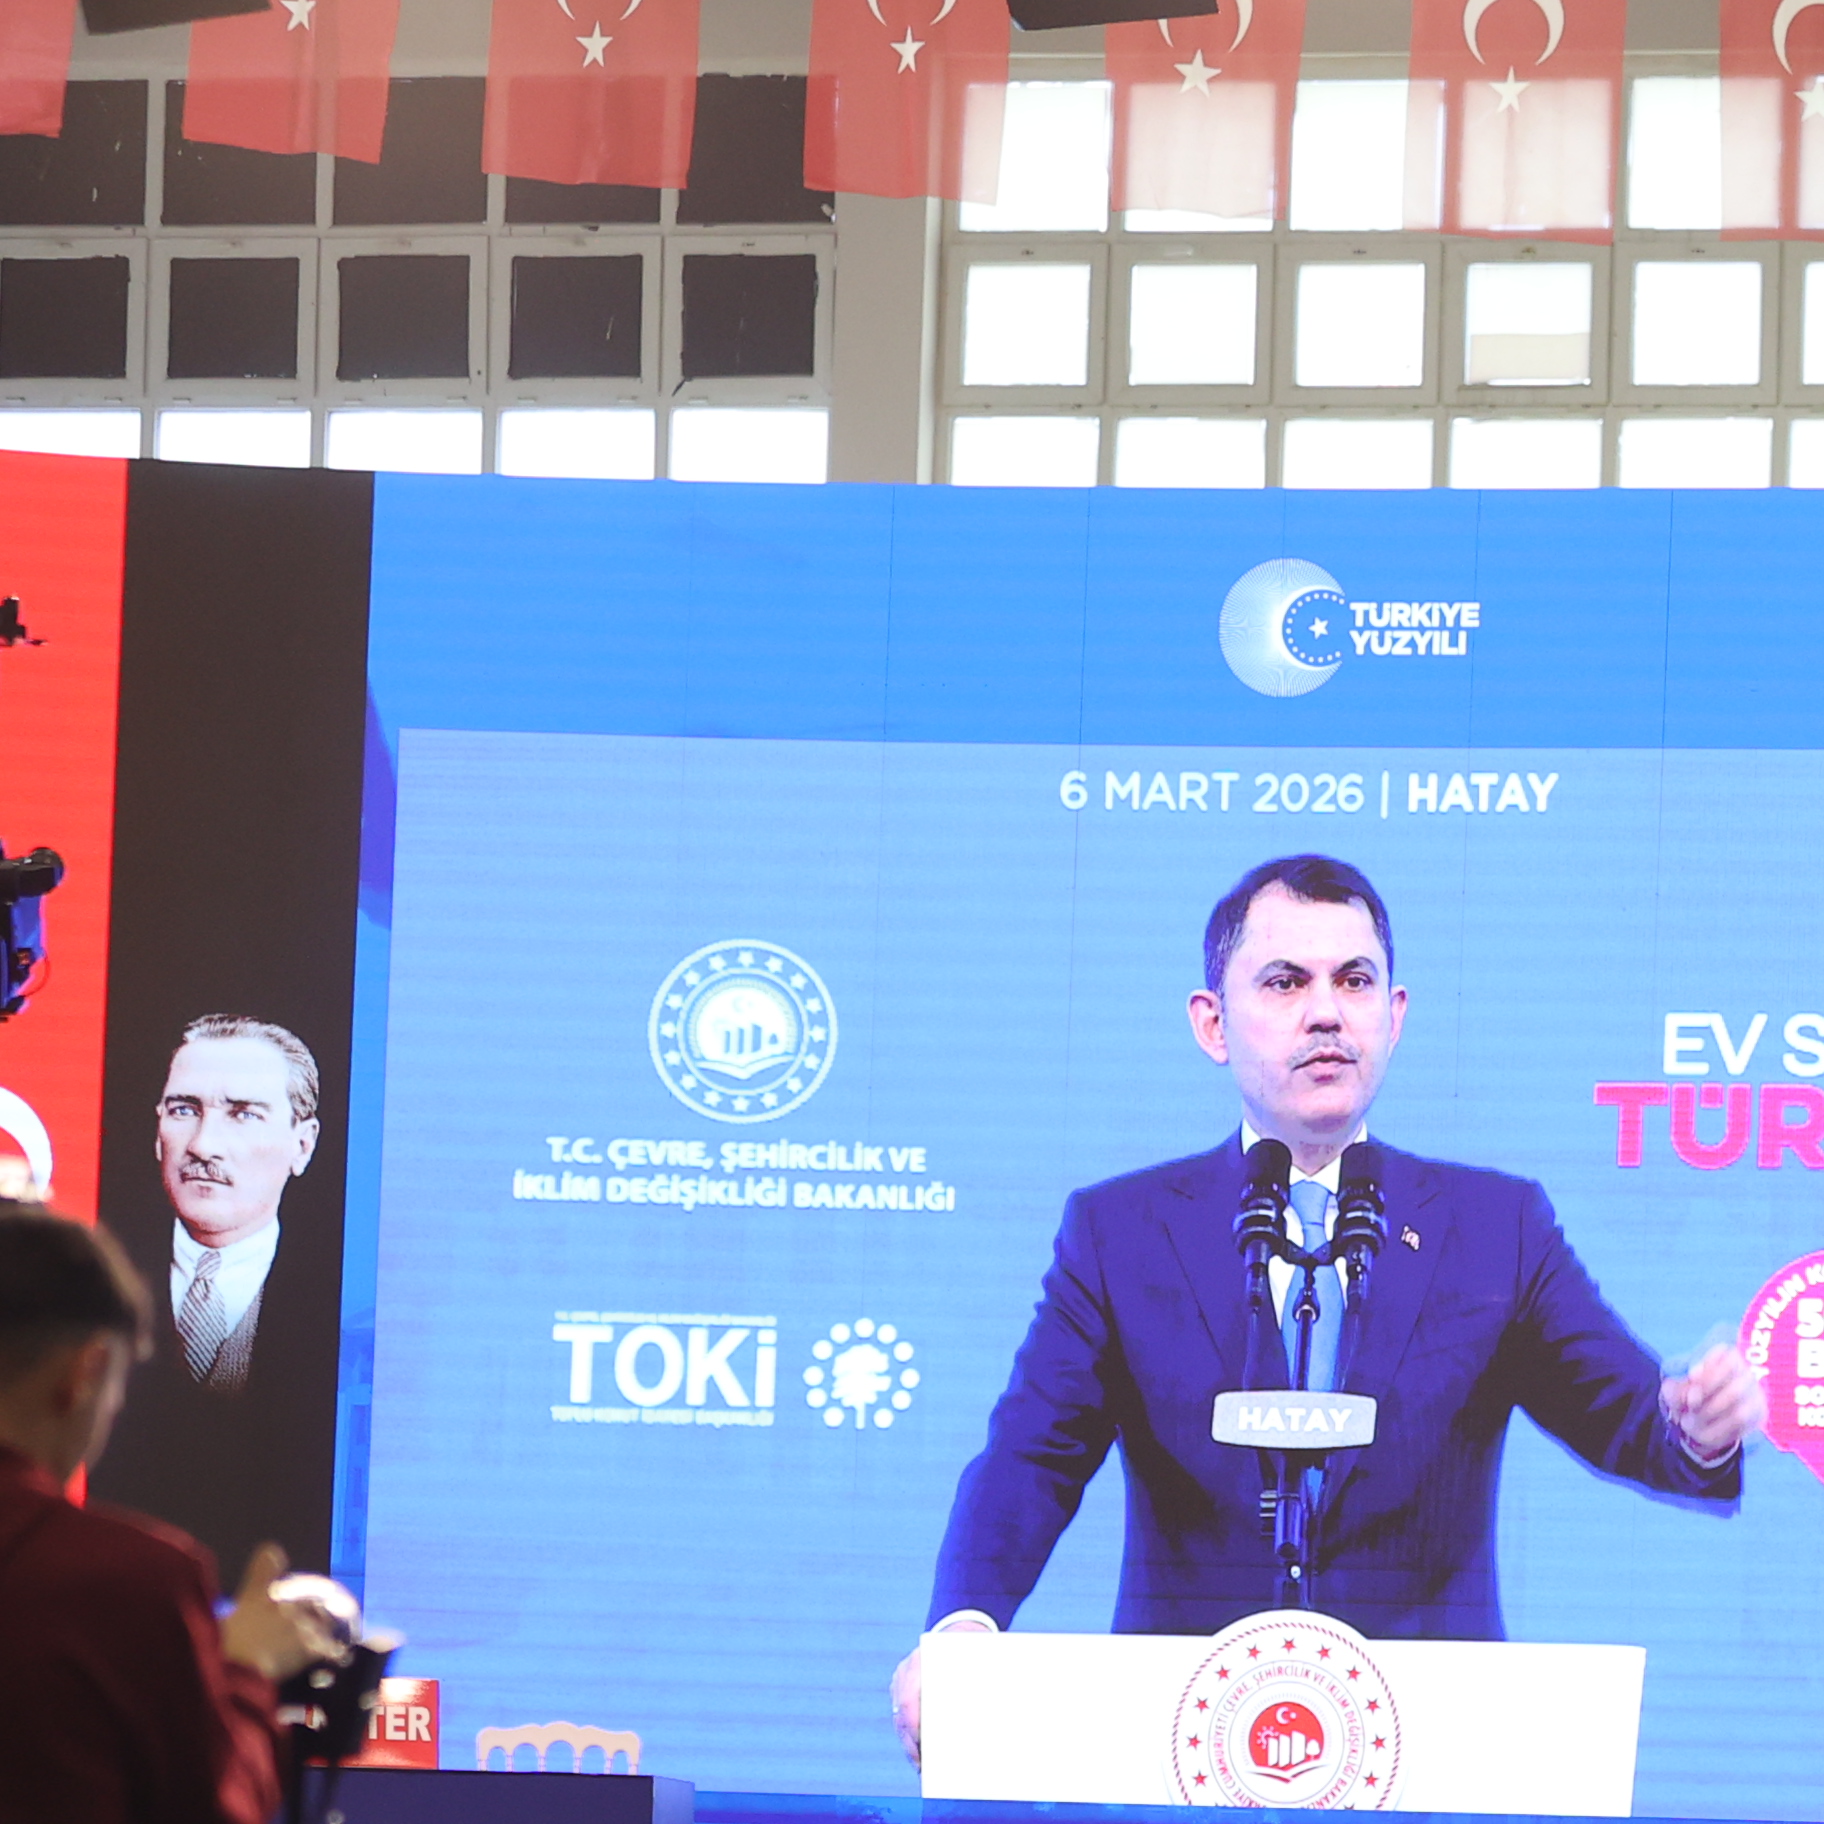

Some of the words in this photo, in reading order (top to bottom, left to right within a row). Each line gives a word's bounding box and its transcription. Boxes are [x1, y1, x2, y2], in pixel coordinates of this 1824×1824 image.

[1059, 771, 1088, 811] 6
[1103, 771, 1240, 812] MART
[1252, 773, 1365, 813] 2026
[1407, 773, 1559, 814] HATAY
[1663, 1013, 1769, 1076] EV
[546, 1137, 602, 1164] T.C.
[607, 1139, 714, 1171] ÇEVRE,
[719, 1139, 883, 1173] ŞEHİRCİLİK
[888, 1147, 927, 1173] VE
[513, 1169, 601, 1201] İKLİM
[606, 1174, 787, 1213] DEĞİŞİKLİĞİ
[793, 1181, 955, 1212] BAKANLIĞI
[1238, 1406, 1352, 1433] HATAY
[368, 1705, 432, 1742] TER
